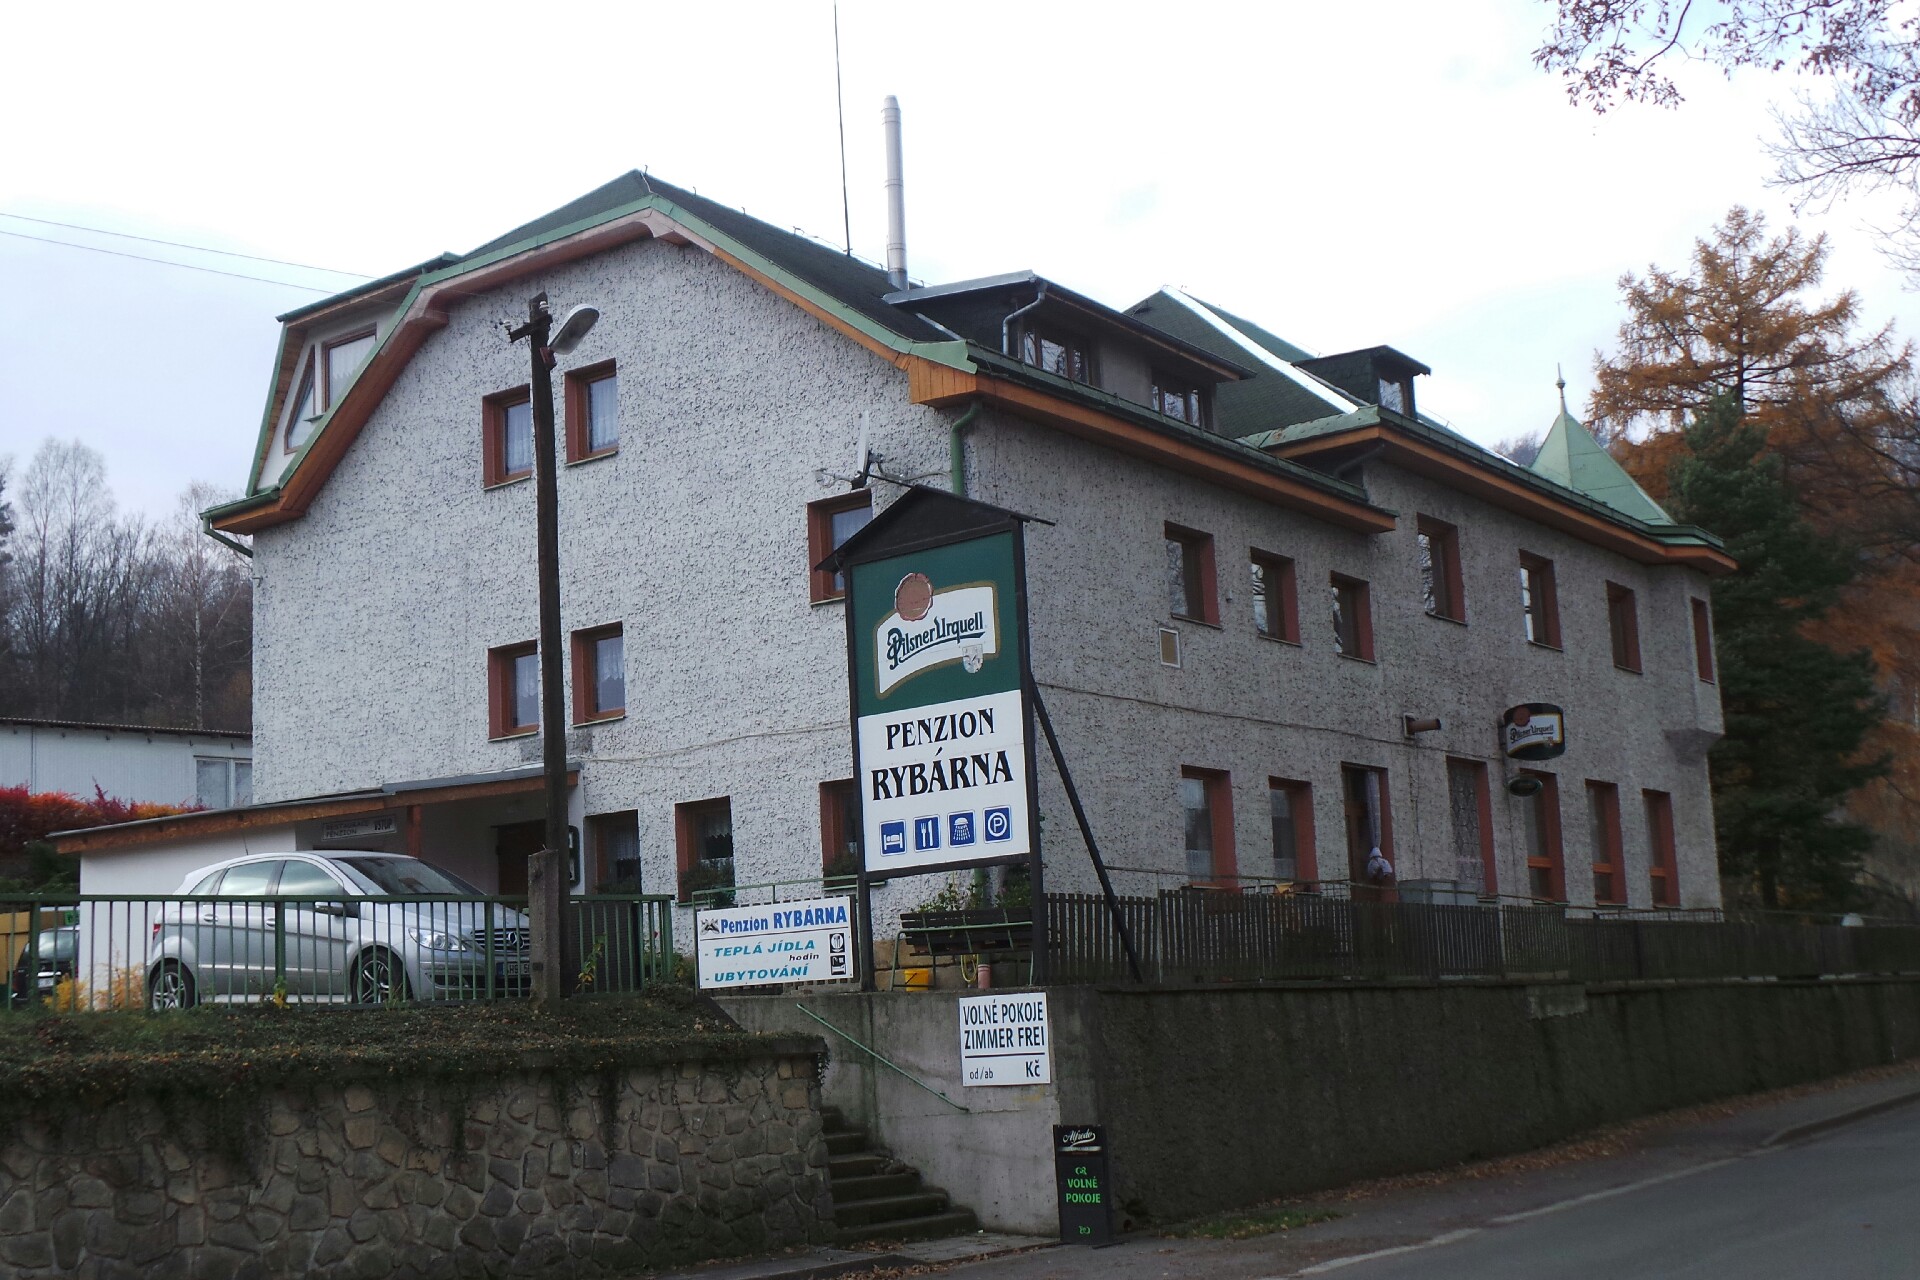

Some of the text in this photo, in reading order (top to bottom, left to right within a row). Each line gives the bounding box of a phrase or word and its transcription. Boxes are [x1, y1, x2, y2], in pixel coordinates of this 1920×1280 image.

[887, 611, 983, 670] Pilsner Urquell
[885, 707, 995, 750] PENZION
[871, 747, 1014, 800] RYBÁRNA
[721, 905, 847, 933] Penzion RYBÁRNA
[713, 941, 763, 957] TEPLÁ
[767, 939, 815, 953] JÍDLA
[788, 953, 820, 961] hodin
[714, 963, 810, 982] UBYTOVÁNÍ
[963, 999, 1044, 1025] VOLNÉ POKOJE
[964, 1026, 1045, 1050] ZIMMER FREI
[1025, 1059, 1040, 1077] Kč
[1067, 1176, 1098, 1188] VOLNÉ
[1066, 1193, 1101, 1204] POKOJE
